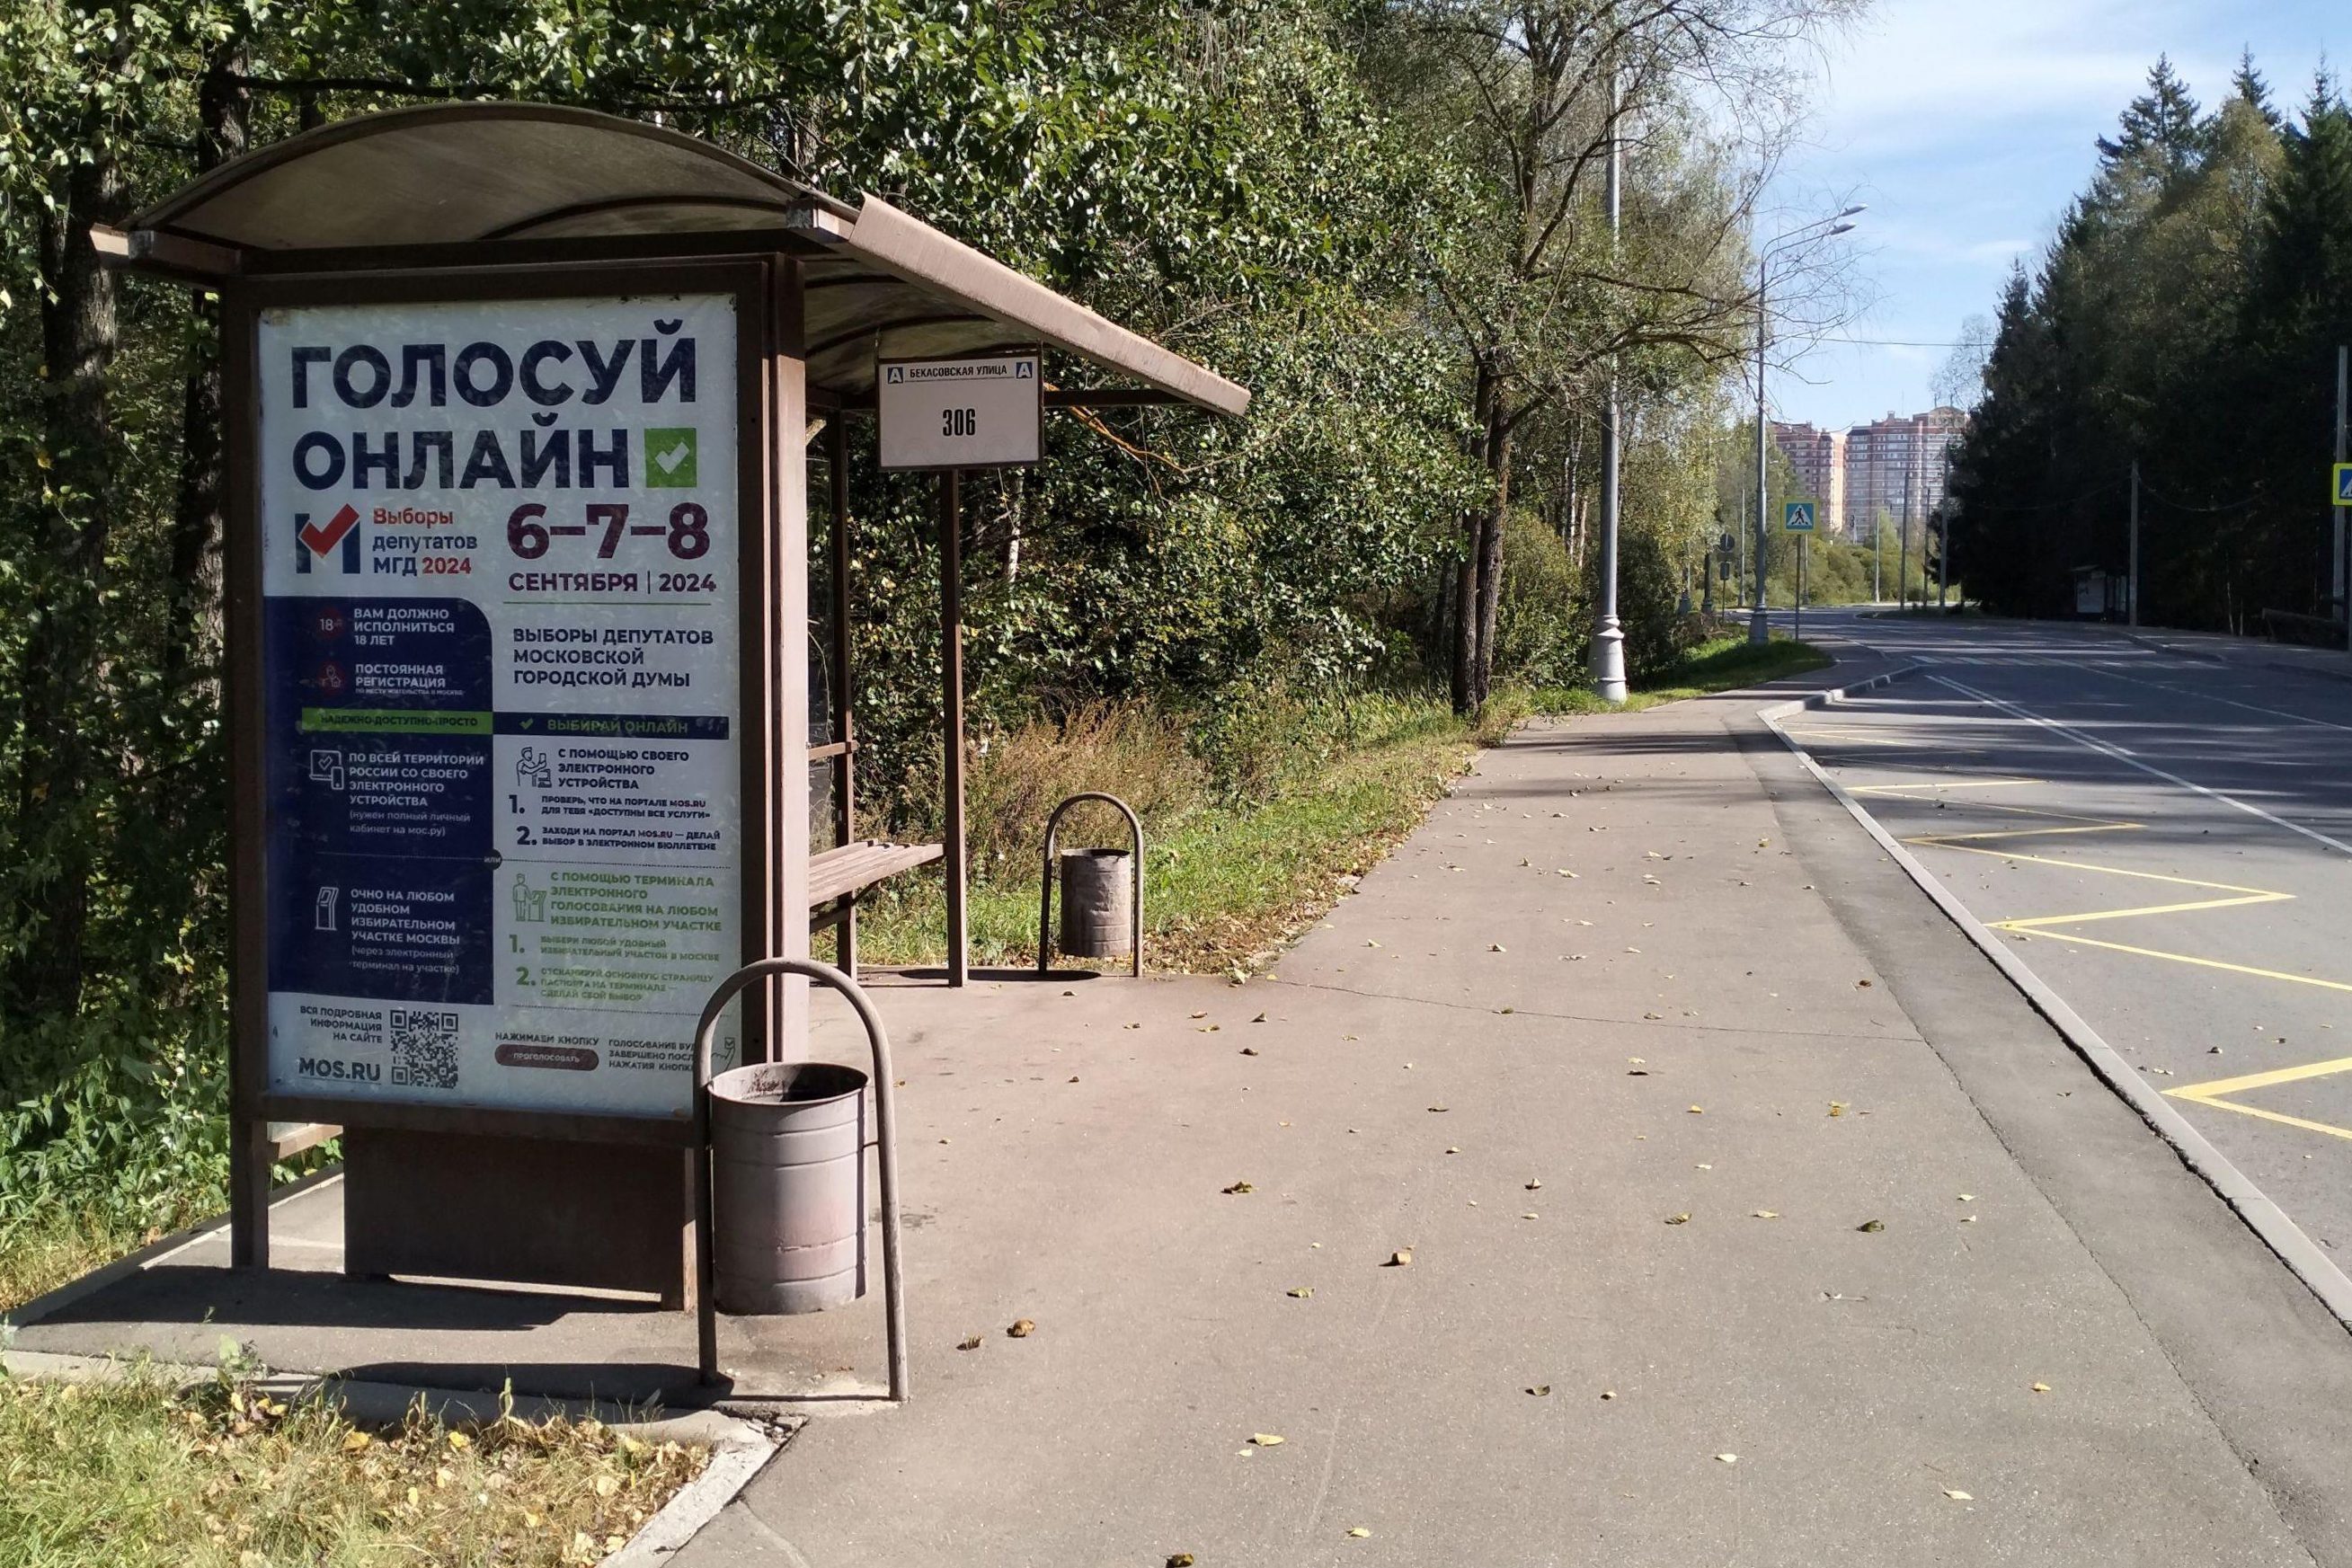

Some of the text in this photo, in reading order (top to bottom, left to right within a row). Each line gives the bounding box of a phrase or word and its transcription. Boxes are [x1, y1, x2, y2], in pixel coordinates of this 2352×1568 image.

[291, 318, 697, 409] ГОЛОСУЙ
[910, 367, 973, 377] БЕКАСОВСКАЯ
[976, 365, 1007, 376] УЛИЦА
[942, 408, 976, 437] 306
[292, 412, 630, 492] ОНЛАЙН
[374, 507, 454, 528] Выборы
[373, 534, 478, 554] депутатов
[374, 556, 472, 577] МГД 2024
[509, 572, 638, 592] СЕНТЯБРЯ
[659, 572, 717, 593] 2024
[354, 608, 449, 620] ВАМ ДОЛЖНО
[354, 622, 455, 633] ИСПОЛНИТЬСЯ
[354, 635, 395, 645] 18 ЛЕТ
[513, 627, 714, 645] ВЫБОРЫ ДЕПУТАТОВ
[513, 647, 643, 665] МОСКОВСКОЙ
[356, 663, 444, 675] ПОСТОЯННАЯ
[356, 678, 446, 689] РЕГИСТРАЦИЯ
[514, 669, 690, 688] ГОРОДСКОЙ ДУМЫ
[547, 716, 688, 733] ВЫБИРАЙ ОНЛАЙН
[349, 751, 484, 766] ПО ВСЕЙ ТЕРРИТОРИИ
[558, 749, 689, 762] С ПОМОЩЬЮ СВОЕГО
[349, 767, 468, 779] РОССИИ СО СВОЕГО
[558, 764, 654, 775] ЭЛЕКТРОННОГО
[349, 782, 444, 793] ЭЛЕКТРОННОГО
[558, 776, 639, 789] УСТРОЙСТВА
[349, 793, 428, 807] УСТРОЙСТВА
[509, 794, 525, 814] 1.
[541, 796, 586, 805] ПРОВЕРЬ,
[589, 797, 607, 805] ЧТО
[625, 798, 667, 807] ПОРТАЛЕ
[349, 810, 471, 822] (нужен полный личный
[563, 807, 586, 816] ТЕБЯ
[588, 808, 645, 818] «ДОСТУПНЫ
[647, 810, 665, 818] ВСЕ
[668, 811, 710, 819] УСЛУГИ»
[350, 825, 390, 834] кабинет
[516, 825, 537, 846] 2.
[542, 827, 581, 836] ЗАХОДИ
[599, 828, 635, 837] ПОРТАЛ
[687, 830, 721, 840] ДЕЛАЙ
[542, 837, 575, 846] ВЫБОР
[586, 839, 654, 849] ЭЛЕКТРОННОМ
[657, 843, 717, 852] БЮЛЛЕТЕНЕ
[551, 872, 714, 887] С ПОМОЩЬЮ ТЕРМИНАЛА
[351, 888, 455, 902] ОЧНО НА ЛЮБОМ
[550, 886, 648, 899] ЭЛЕКТРОННОГО
[351, 902, 410, 915] УДОБНОМ
[551, 900, 719, 917] ГОЛОСОВАНИЯ НА ЛЮБОМ
[351, 917, 456, 930] ИЗБИРАТЕЛЬНОМ
[550, 917, 723, 932] ИЗБИРАТЕЛЬНОМ УЧАСТКЕ
[351, 931, 460, 945] УЧАСТКЕ МОСКВЫ
[509, 934, 525, 953] 1.
[351, 945, 453, 960] (через электронный
[352, 961, 399, 971] терминал
[516, 967, 537, 987] 2.
[300, 1005, 382, 1020] ВСЯ ПОДРОБНАЯ
[310, 1018, 382, 1032] ИНФОРМАЦИЯ
[333, 1032, 383, 1043] НА САЙТЕ
[495, 1032, 599, 1047] НАЖИМАЕМ КНОПКУ
[609, 1039, 677, 1050] ГОЛОСОВАНИЕ
[609, 1050, 665, 1060] ЗАВЕРШЕНО
[298, 1057, 381, 1082] MOS.RU
[609, 1060, 654, 1070] НАЖАТИЯ
